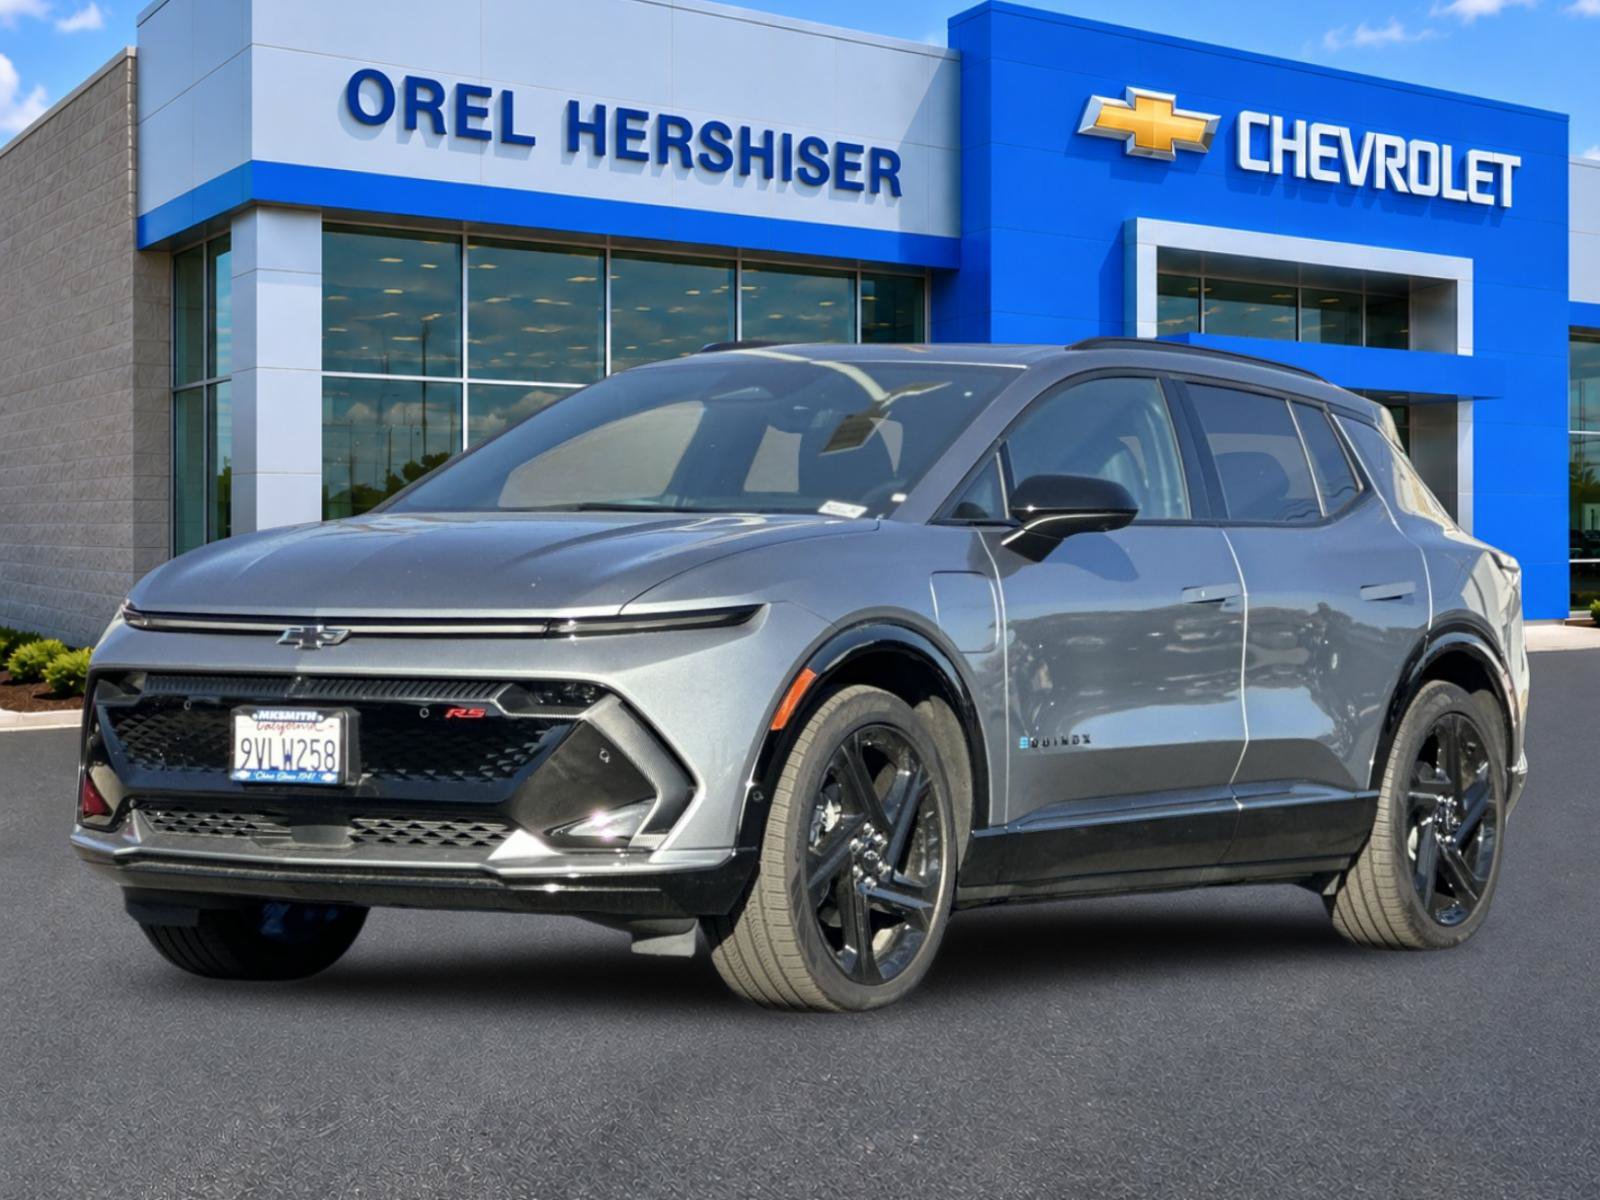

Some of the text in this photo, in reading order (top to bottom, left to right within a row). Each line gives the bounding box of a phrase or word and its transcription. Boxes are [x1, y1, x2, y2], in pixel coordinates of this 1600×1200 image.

[346, 68, 902, 198] OREL HERSHISER
[1238, 110, 1522, 208] CHEVROLET
[446, 708, 486, 718] RS
[240, 737, 336, 771] 9VLW258
[1019, 734, 1091, 749] EQUINOX
